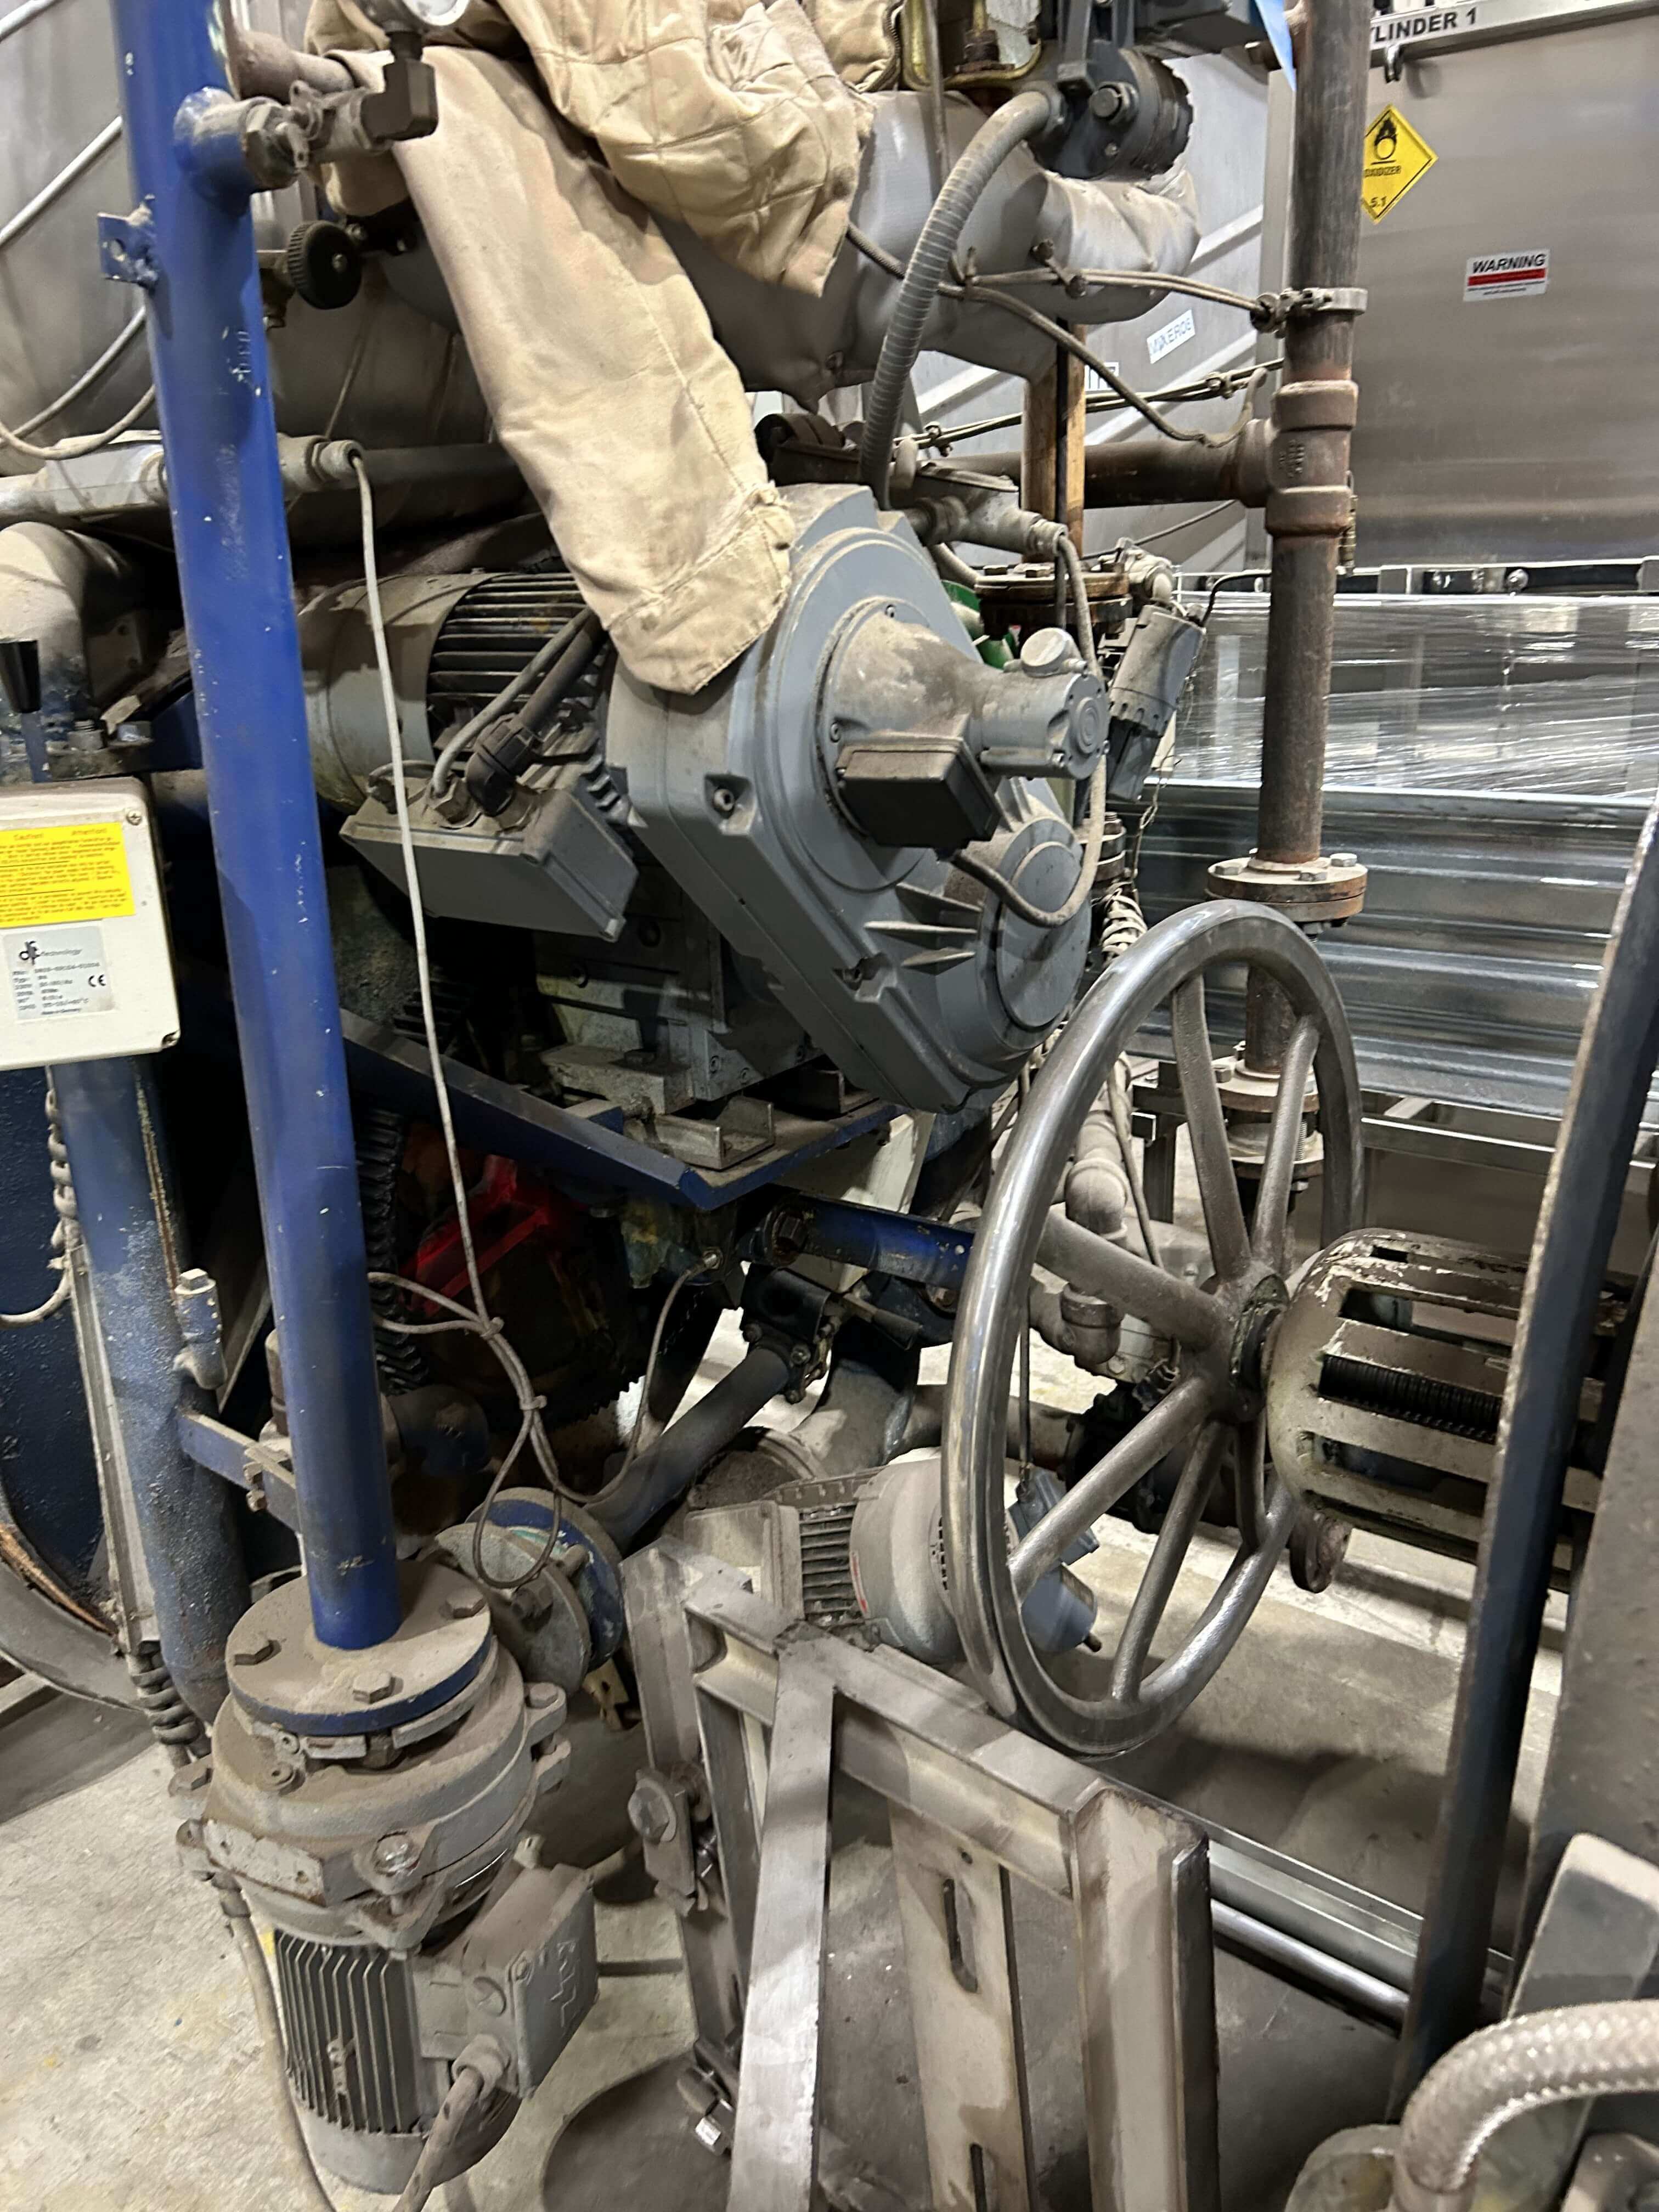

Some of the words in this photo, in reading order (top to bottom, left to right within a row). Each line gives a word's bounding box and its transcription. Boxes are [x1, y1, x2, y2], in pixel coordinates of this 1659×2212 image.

[1370, 12, 1457, 42] LINDER
[1465, 7, 1477, 25] 1
[1369, 196, 1387, 208] 5.1
[1472, 253, 1547, 274] WARNING
[88, 974, 107, 988] CE
